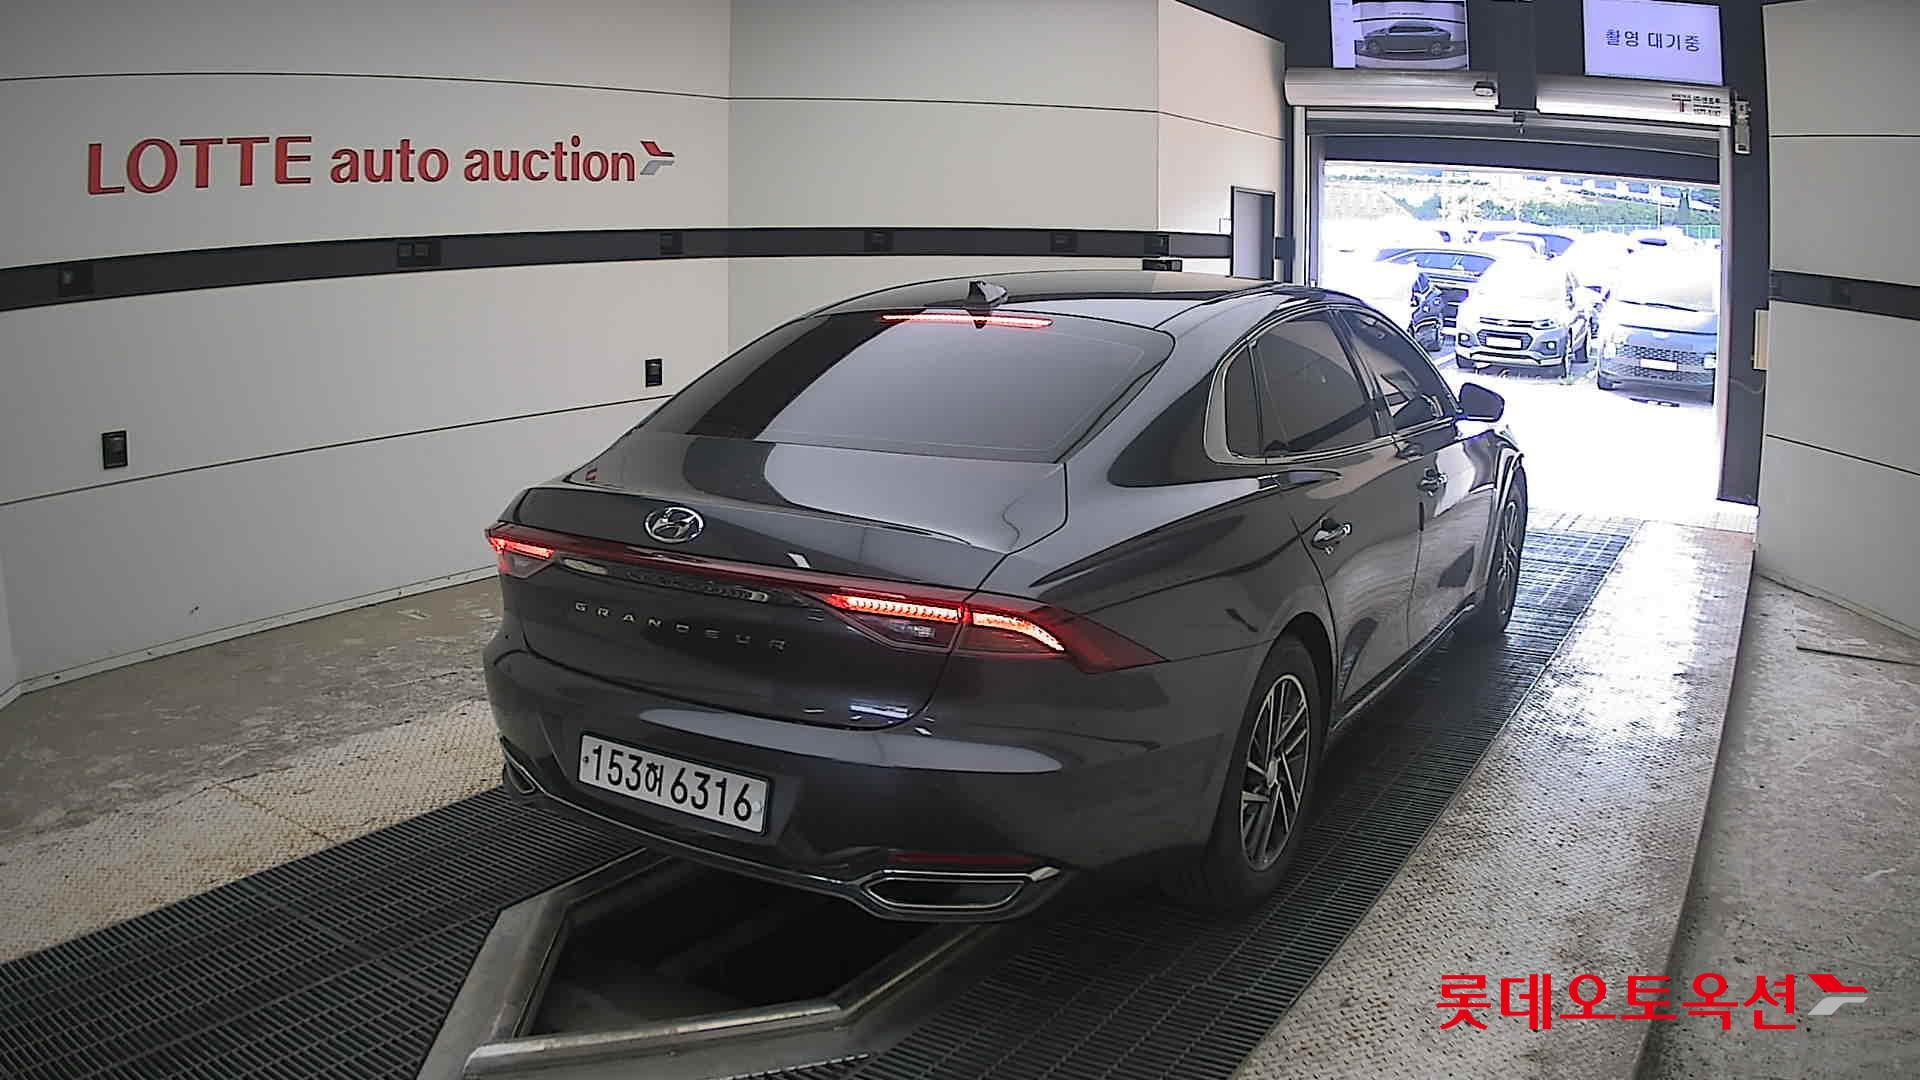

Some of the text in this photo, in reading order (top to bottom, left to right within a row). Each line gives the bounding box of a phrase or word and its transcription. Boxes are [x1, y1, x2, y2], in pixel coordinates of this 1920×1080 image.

[1648, 32, 1700, 52] 대기중
[88, 135, 636, 195] LOTTE auto auction
[574, 601, 786, 654] GRANDEUR
